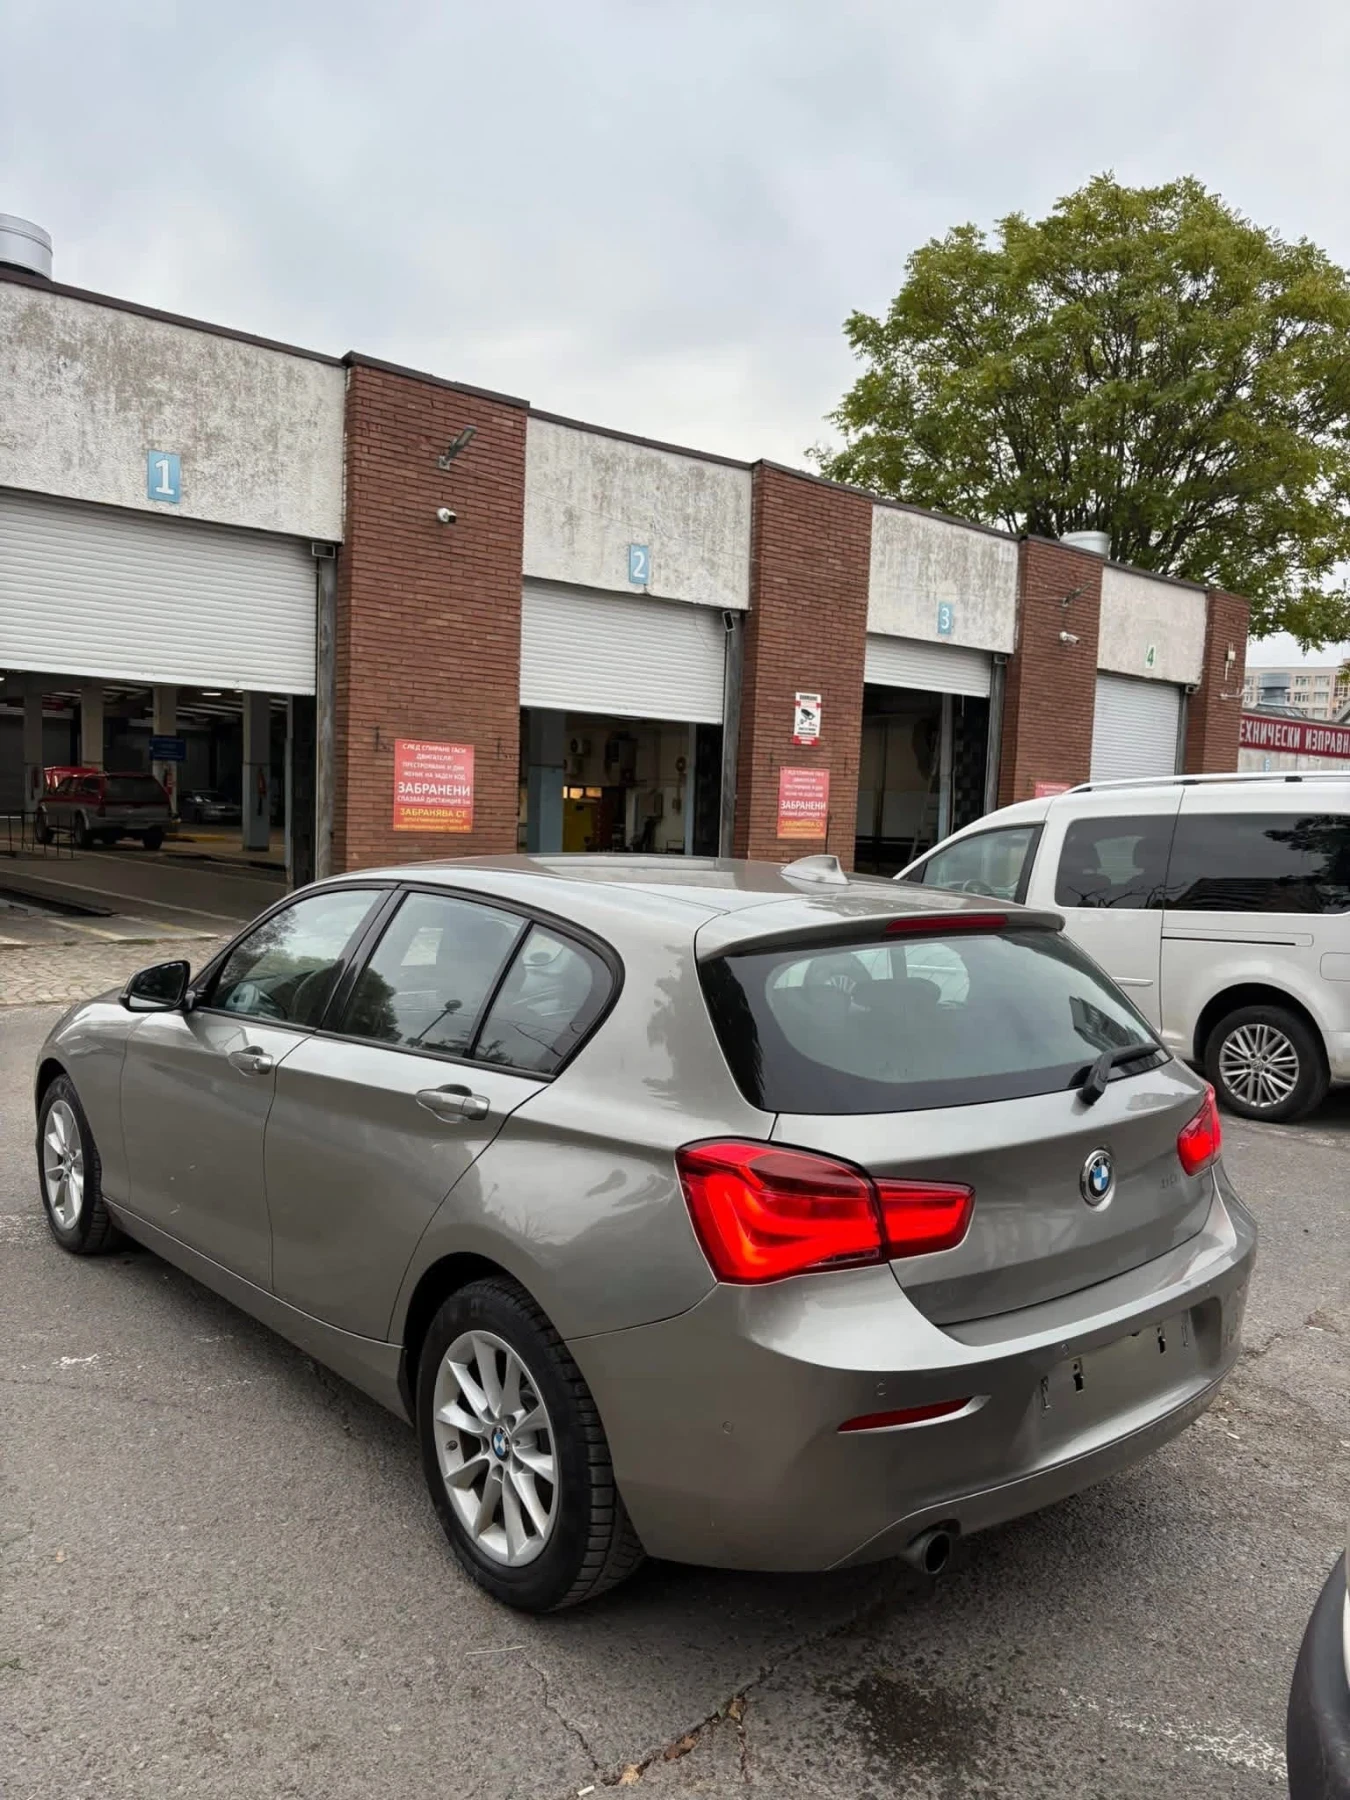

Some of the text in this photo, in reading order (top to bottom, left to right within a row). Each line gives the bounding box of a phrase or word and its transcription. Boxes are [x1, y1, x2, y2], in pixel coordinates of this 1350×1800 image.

[155, 459, 175, 495] 1
[633, 551, 645, 578] 2
[941, 607, 950, 630] 3
[1147, 646, 1154, 667] 4
[1305, 728, 1350, 754] ИЗПРАВН
[398, 781, 471, 797] ЗАБРАНЕНИ
[400, 807, 468, 818] ЗАБРАНЯВА СЕ
[780, 799, 826, 811] ЗАБРАНЕНИ
